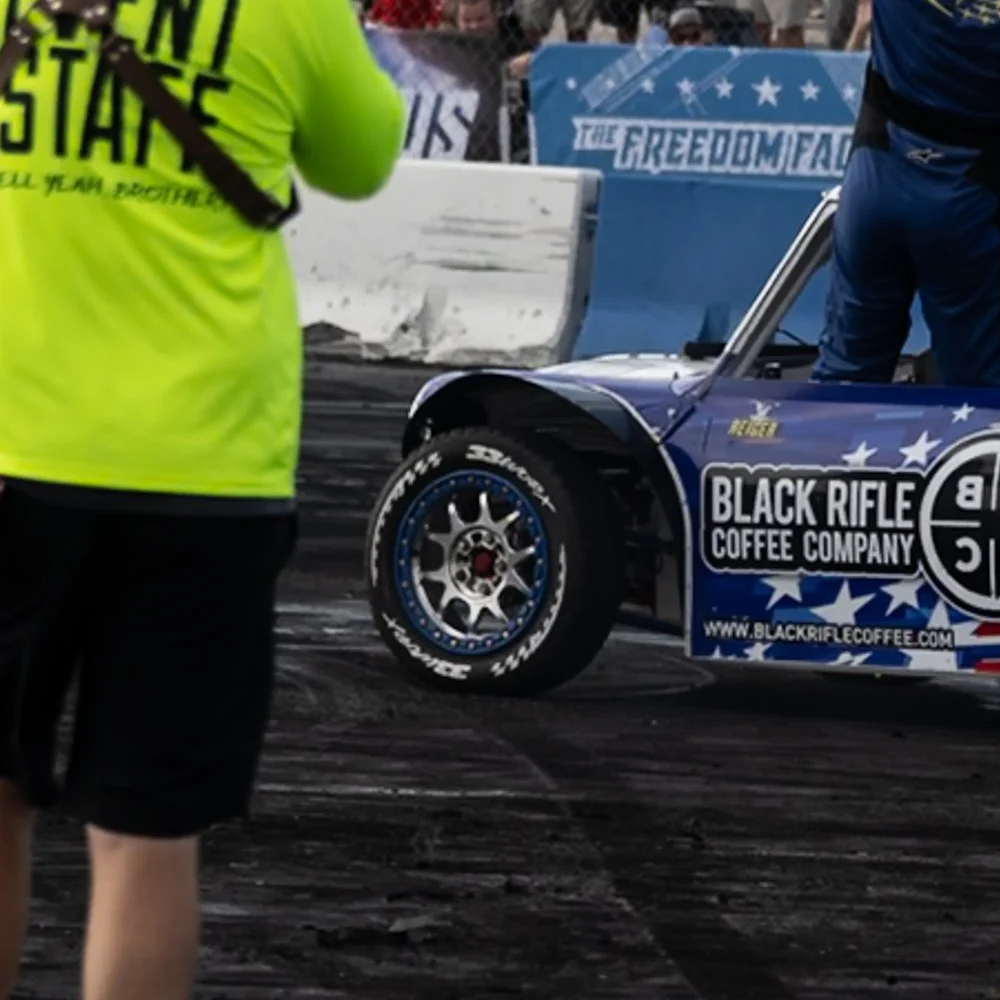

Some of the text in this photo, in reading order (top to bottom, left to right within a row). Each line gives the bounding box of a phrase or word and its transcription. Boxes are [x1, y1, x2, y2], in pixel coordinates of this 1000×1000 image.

[578, 122, 617, 145] THE
[617, 126, 785, 174] FREEDOM
[711, 475, 916, 529] BLACK RIFLE
[711, 527, 915, 566] COFFEE COMPANY
[703, 619, 954, 648] WWW.BLACKRIFLECOFFEE.COM
